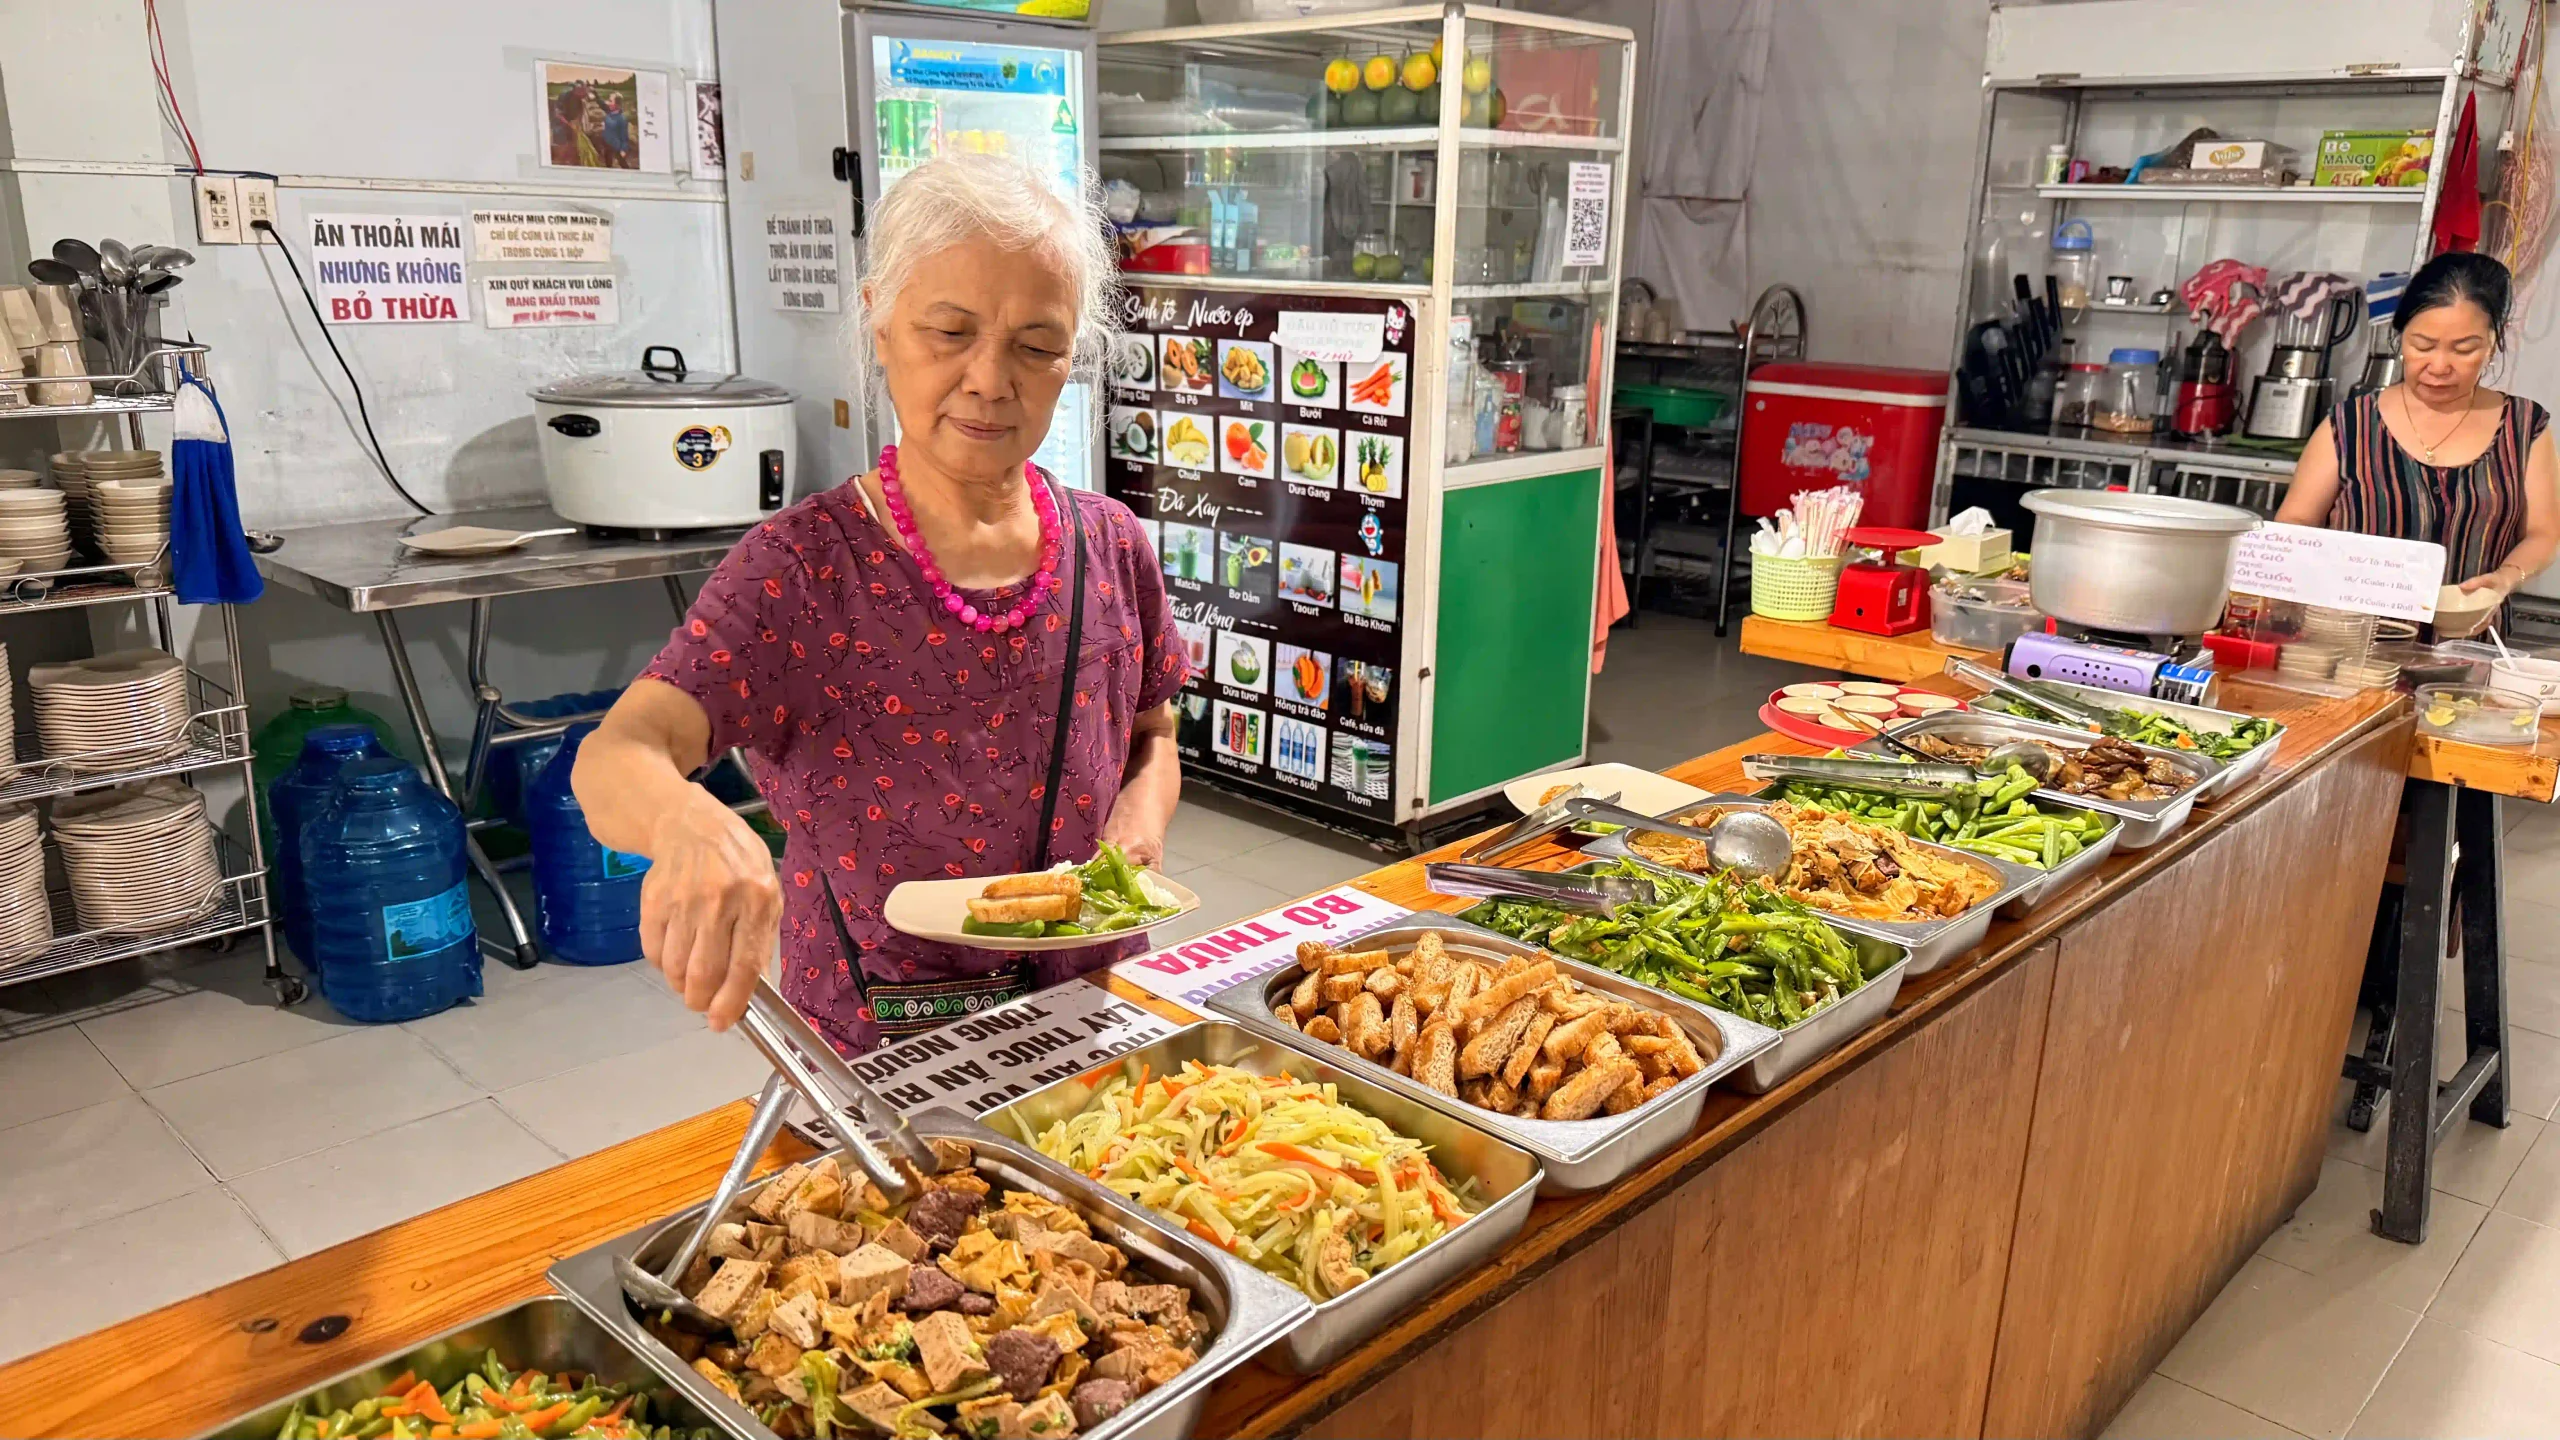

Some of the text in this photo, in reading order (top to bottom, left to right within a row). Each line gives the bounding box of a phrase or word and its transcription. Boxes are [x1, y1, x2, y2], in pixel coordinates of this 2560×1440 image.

[2324, 154, 2376, 165] MANGO
[493, 214, 524, 225] KHÁCH
[526, 214, 545, 225] MUA
[548, 215, 568, 225] CƠM
[570, 215, 597, 226] MANG
[314, 218, 461, 248] ĂN THOẢI MÁI
[544, 228, 555, 241] VÀ
[502, 246, 532, 258] TRONG
[319, 257, 462, 284] NHƯNG KHÔNG
[489, 279, 507, 290] XIN
[532, 278, 566, 290] KHÁCH
[568, 279, 585, 290] VUI
[587, 277, 613, 289] LÒNG
[332, 290, 457, 320] BỎ THỪA
[506, 296, 537, 307] MANG
[568, 295, 600, 306] TRANG
[1125, 295, 1159, 323] Sinh
[1234, 307, 1254, 338] ép
[1175, 393, 1186, 404] Sa
[692, 451, 704, 468] 3
[1238, 476, 1257, 488] Cam
[1288, 483, 1331, 501] Dưa Gang
[1157, 486, 1221, 528] Đá Xay
[1360, 494, 1385, 508] Thơm
[1174, 577, 1202, 592] Matcha
[2255, 570, 2293, 584] CUỐN
[1228, 588, 1242, 600] Bơ
[1194, 601, 1236, 633] Uống
[1292, 602, 1319, 616] Yaourt
[1241, 690, 1259, 703] tươi
[1297, 703, 1309, 716] trà
[1216, 753, 1258, 775] Nước ngọt
[1275, 771, 1299, 786] Nước
[1346, 790, 1372, 807] Thơm
[1281, 893, 1365, 931] BỎ
[1134, 921, 1292, 976] THỪA
[964, 1001, 1053, 1043] TỪNG
[1082, 1001, 1149, 1034] LẤY
[987, 1025, 1087, 1068] THỨC
[926, 1059, 993, 1092] ĂN
